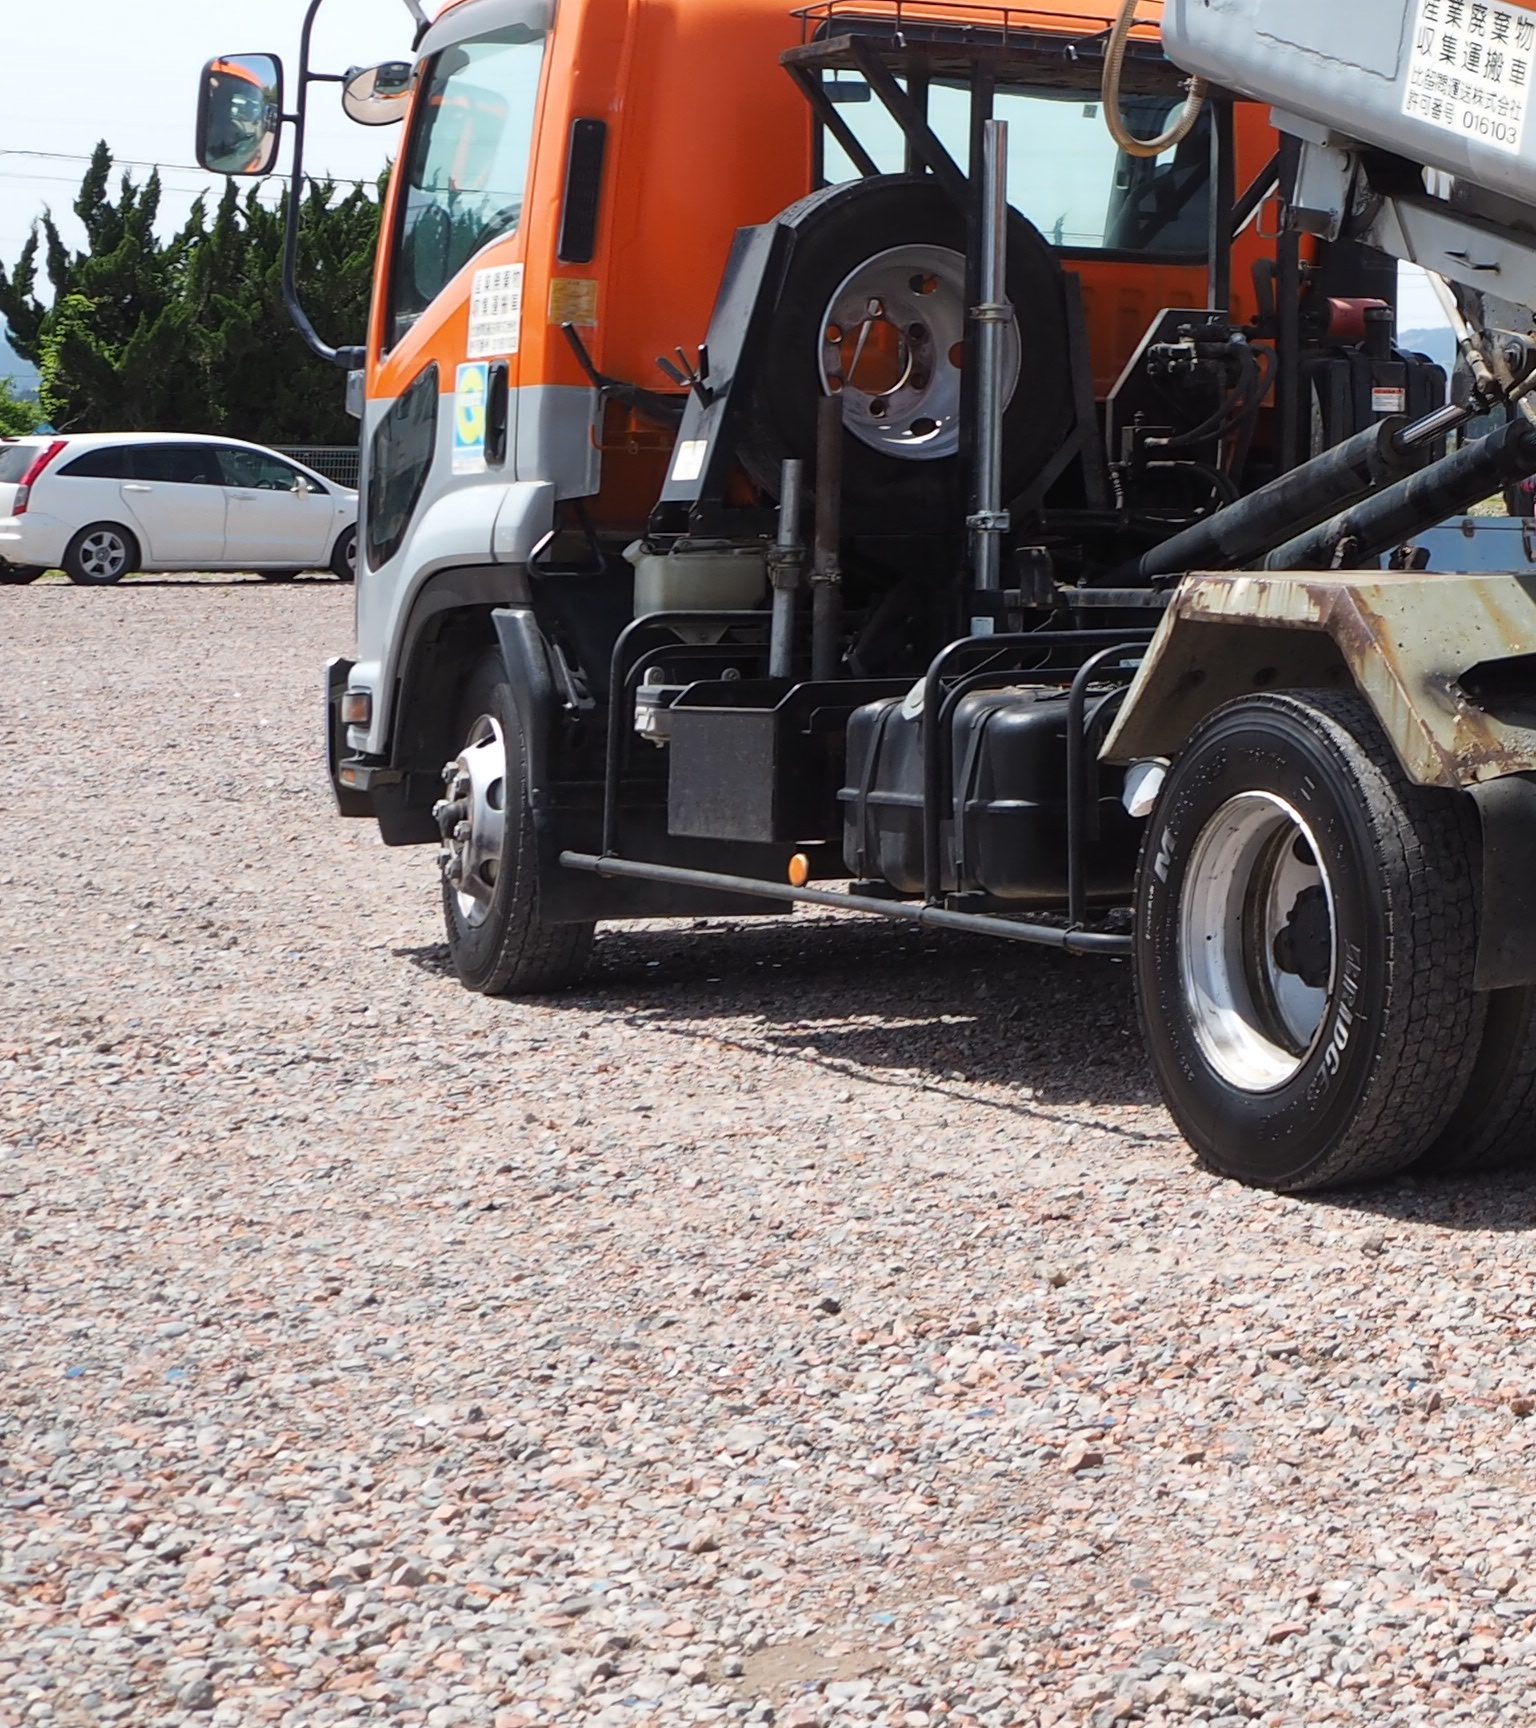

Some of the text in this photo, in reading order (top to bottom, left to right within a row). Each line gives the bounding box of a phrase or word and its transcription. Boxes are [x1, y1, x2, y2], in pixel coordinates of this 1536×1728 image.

[1417, 25, 1529, 87] 収集運搬車
[1463, 110, 1517, 144] 016103
